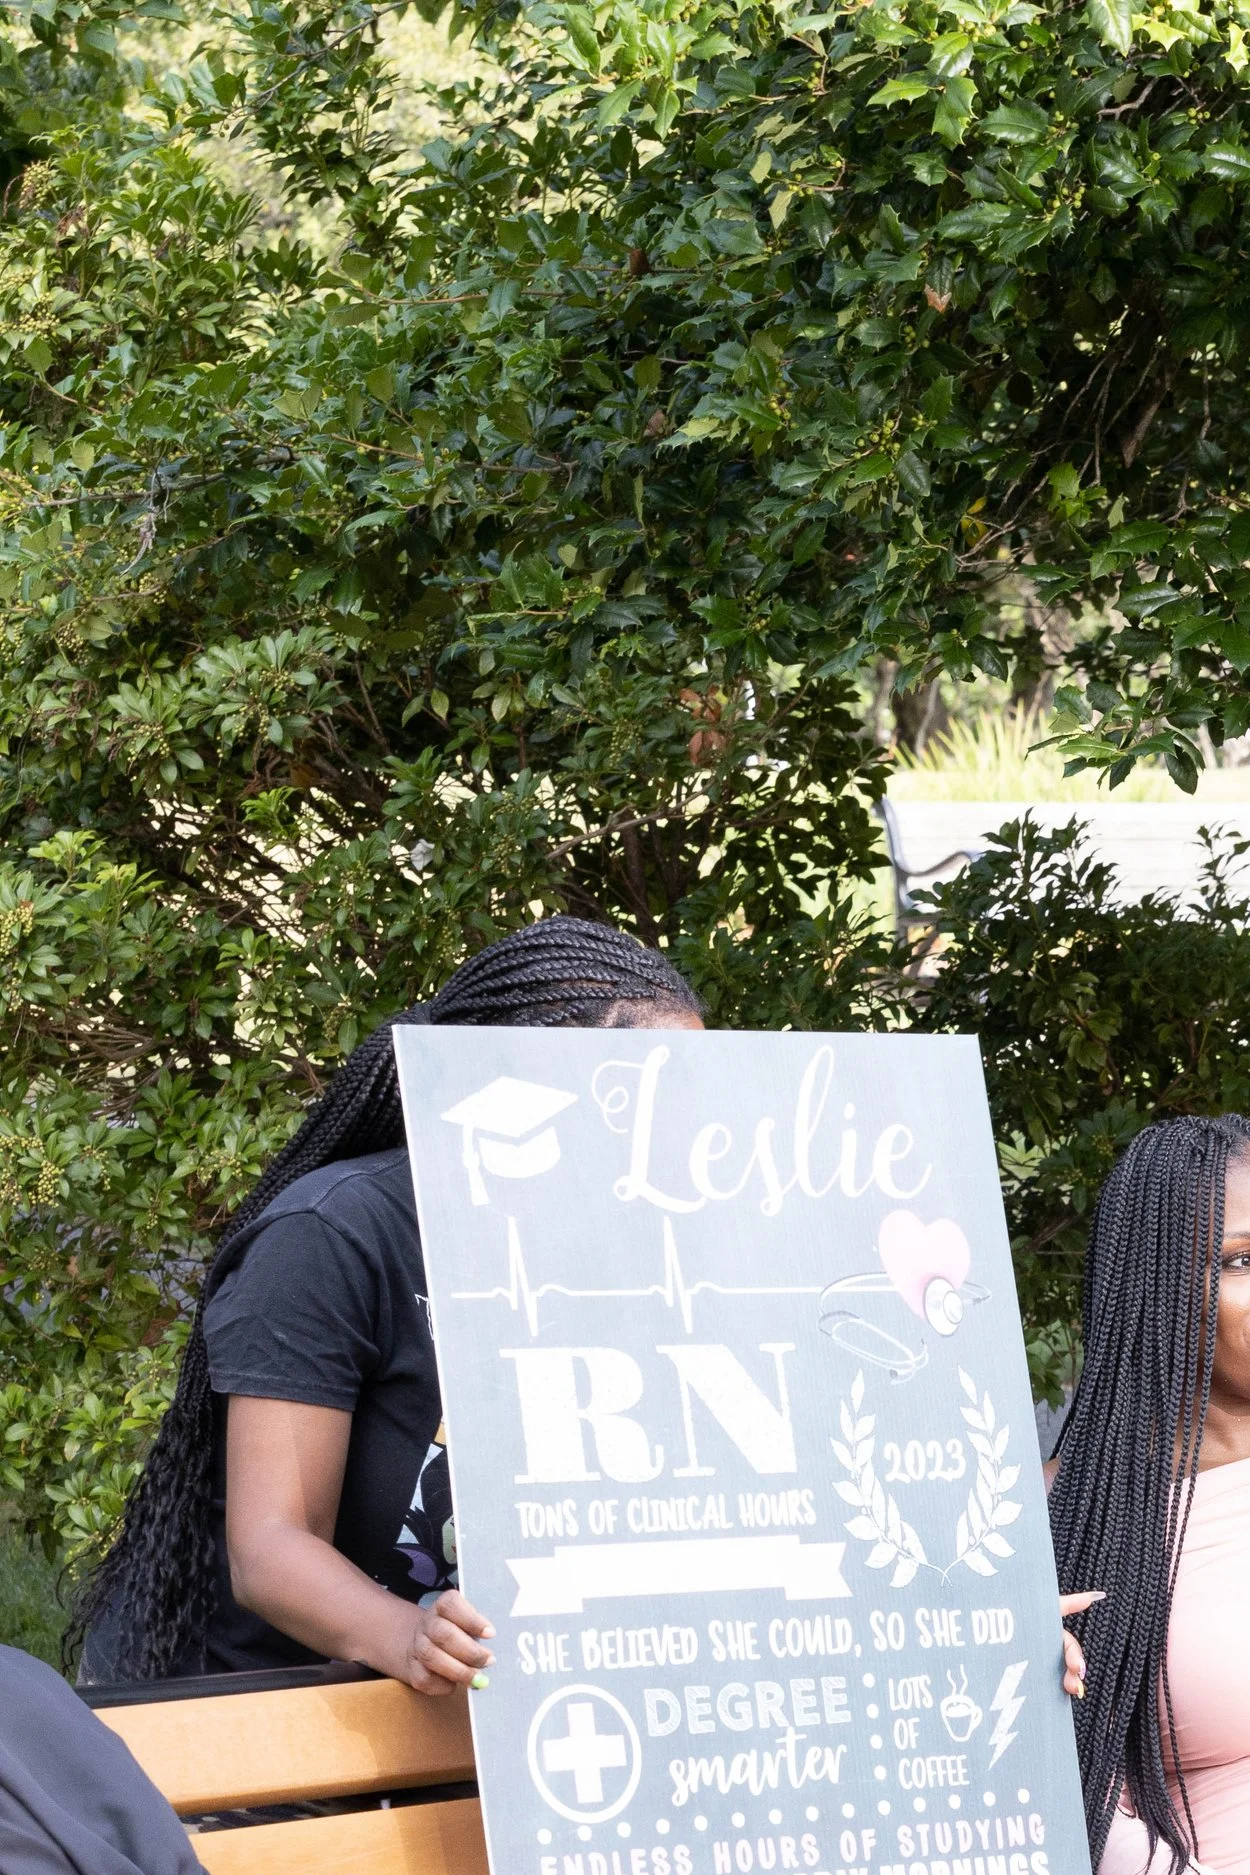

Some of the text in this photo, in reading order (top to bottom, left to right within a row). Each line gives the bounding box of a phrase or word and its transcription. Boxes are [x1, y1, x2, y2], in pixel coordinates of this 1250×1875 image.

[592, 1045, 933, 1217] Leslie
[500, 1344, 795, 1484] RN
[884, 1439, 966, 1484] 2023
[515, 1490, 817, 1538] TONS OF CLINICAL HOURS
[517, 1608, 1013, 1675] SHE BELIEVED SHE COULD, SO SHE DID
[643, 1676, 851, 1736] DEGREE
[888, 1674, 933, 1710] LOTS
[894, 1717, 920, 1750] OF
[669, 1727, 847, 1806] smarter
[898, 1756, 969, 1790] COFFEE
[840, 1829, 876, 1862] OF
[898, 1813, 1045, 1857] STUDYING
